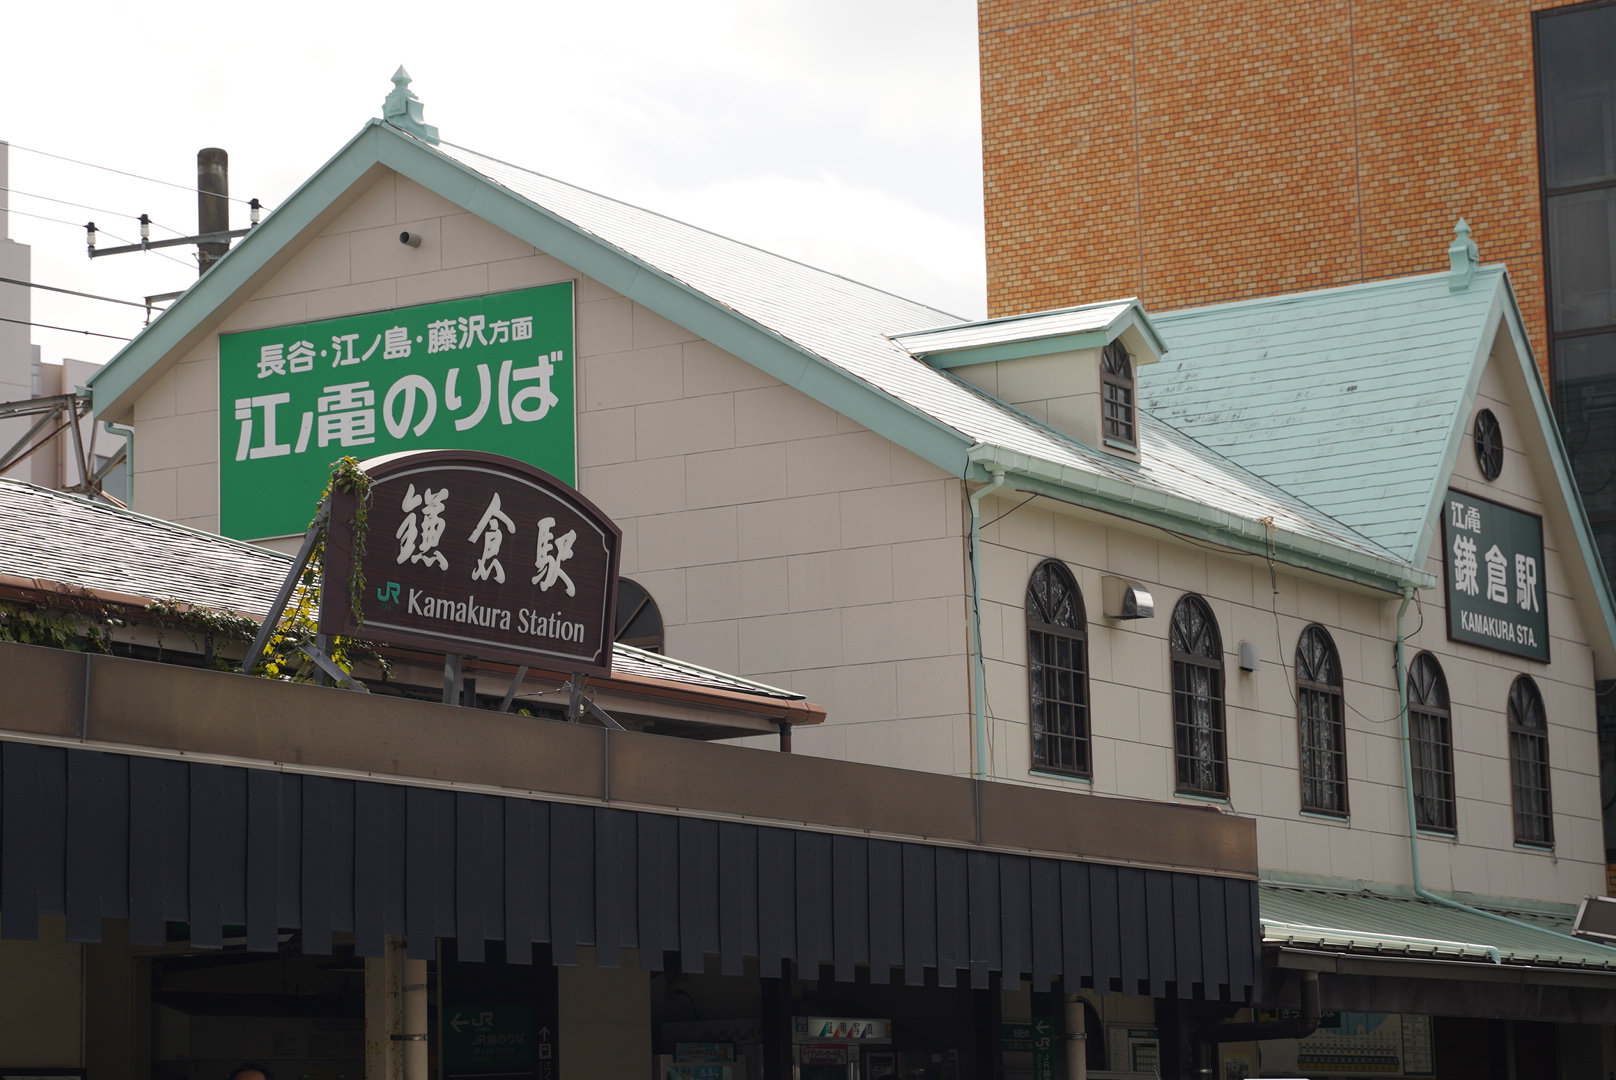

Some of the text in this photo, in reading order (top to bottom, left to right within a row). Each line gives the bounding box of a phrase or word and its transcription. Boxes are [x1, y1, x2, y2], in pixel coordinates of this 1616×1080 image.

[257, 314, 534, 379] 長谷・江ノ島・藤沢方面
[235, 350, 564, 462] 江ノ電のりば
[395, 483, 577, 598] 鎌倉駅
[1453, 533, 1540, 613] 鎌倉駅
[377, 581, 401, 604] JR
[408, 588, 585, 643] Kamakura Station
[1460, 610, 1538, 648] KAMAKURA STA.
[471, 1011, 494, 1027] JR
[827, 1021, 874, 1036] 証明写真
[471, 1032, 526, 1046] JR線のりば
[1036, 1037, 1051, 1047] JR
[543, 1061, 552, 1080] 江ノ
